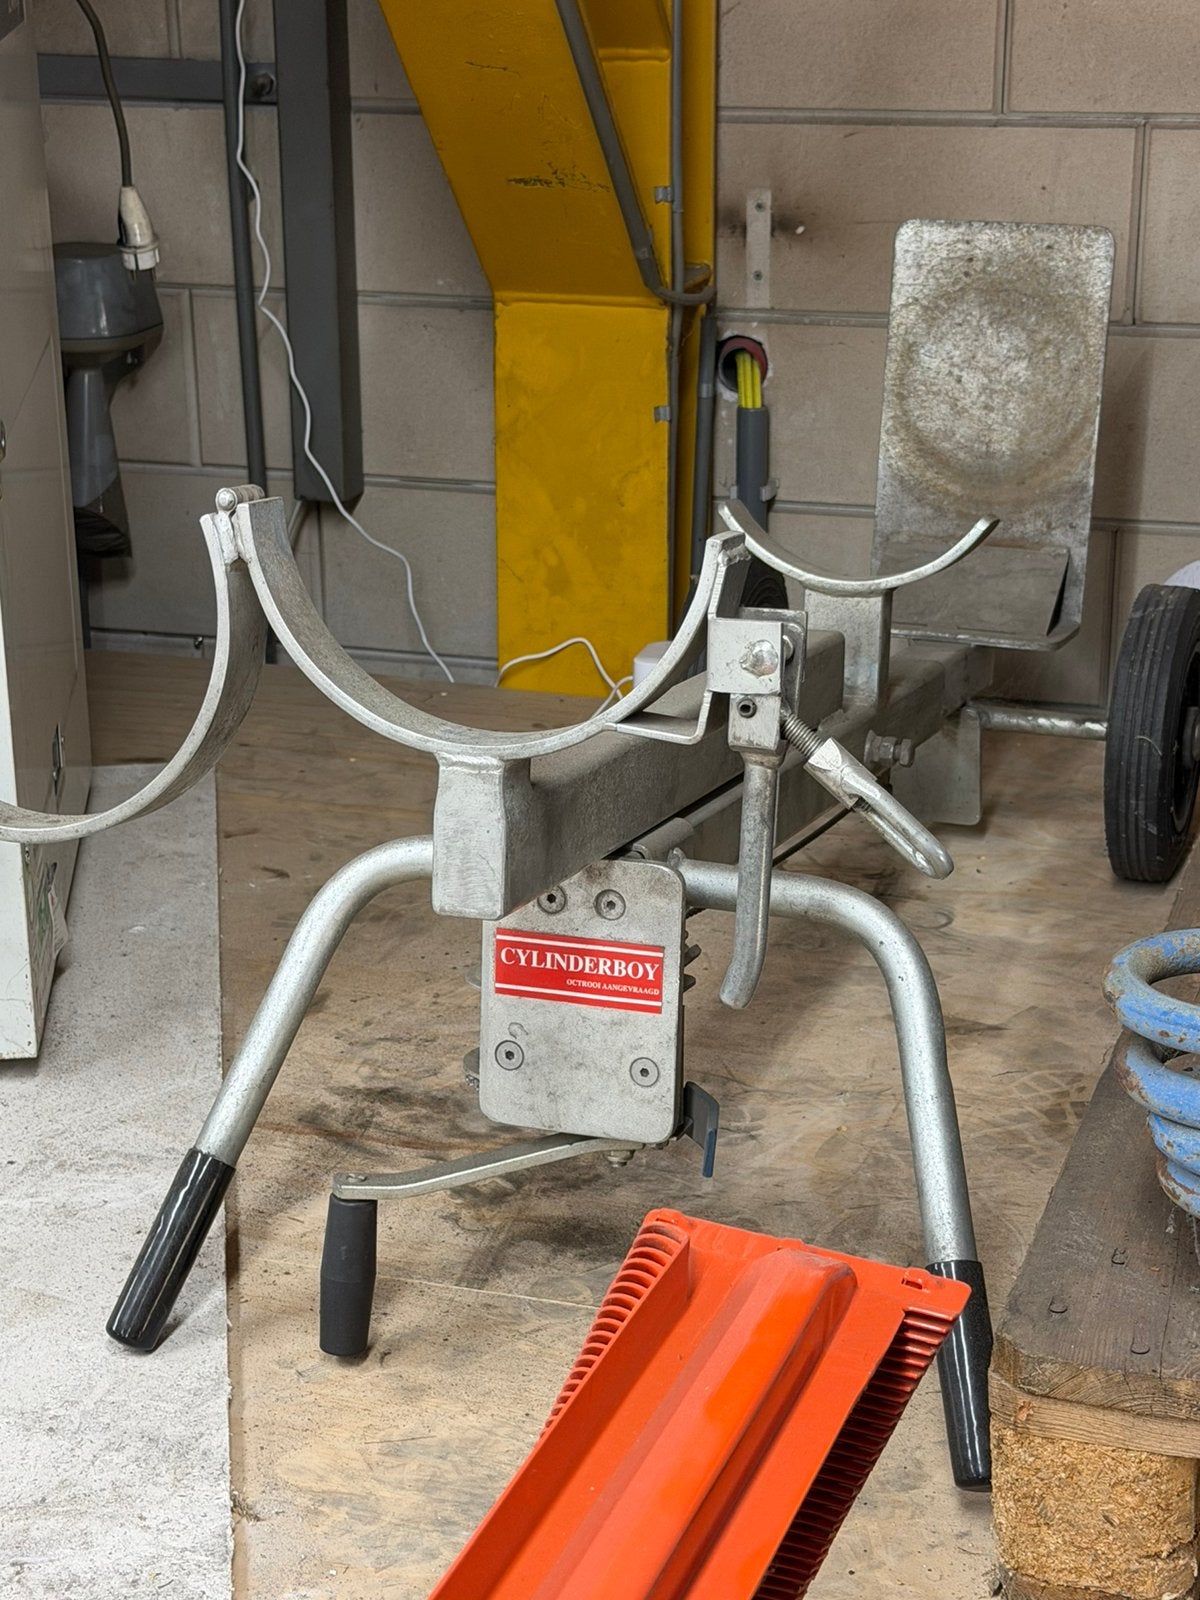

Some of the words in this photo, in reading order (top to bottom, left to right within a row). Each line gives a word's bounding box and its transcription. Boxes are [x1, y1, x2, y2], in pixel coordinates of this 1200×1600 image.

[500, 946, 659, 980] CYLINDERBOY
[566, 978, 601, 989] OCTROOI
[602, 983, 660, 996] AANGEVRAAGD
